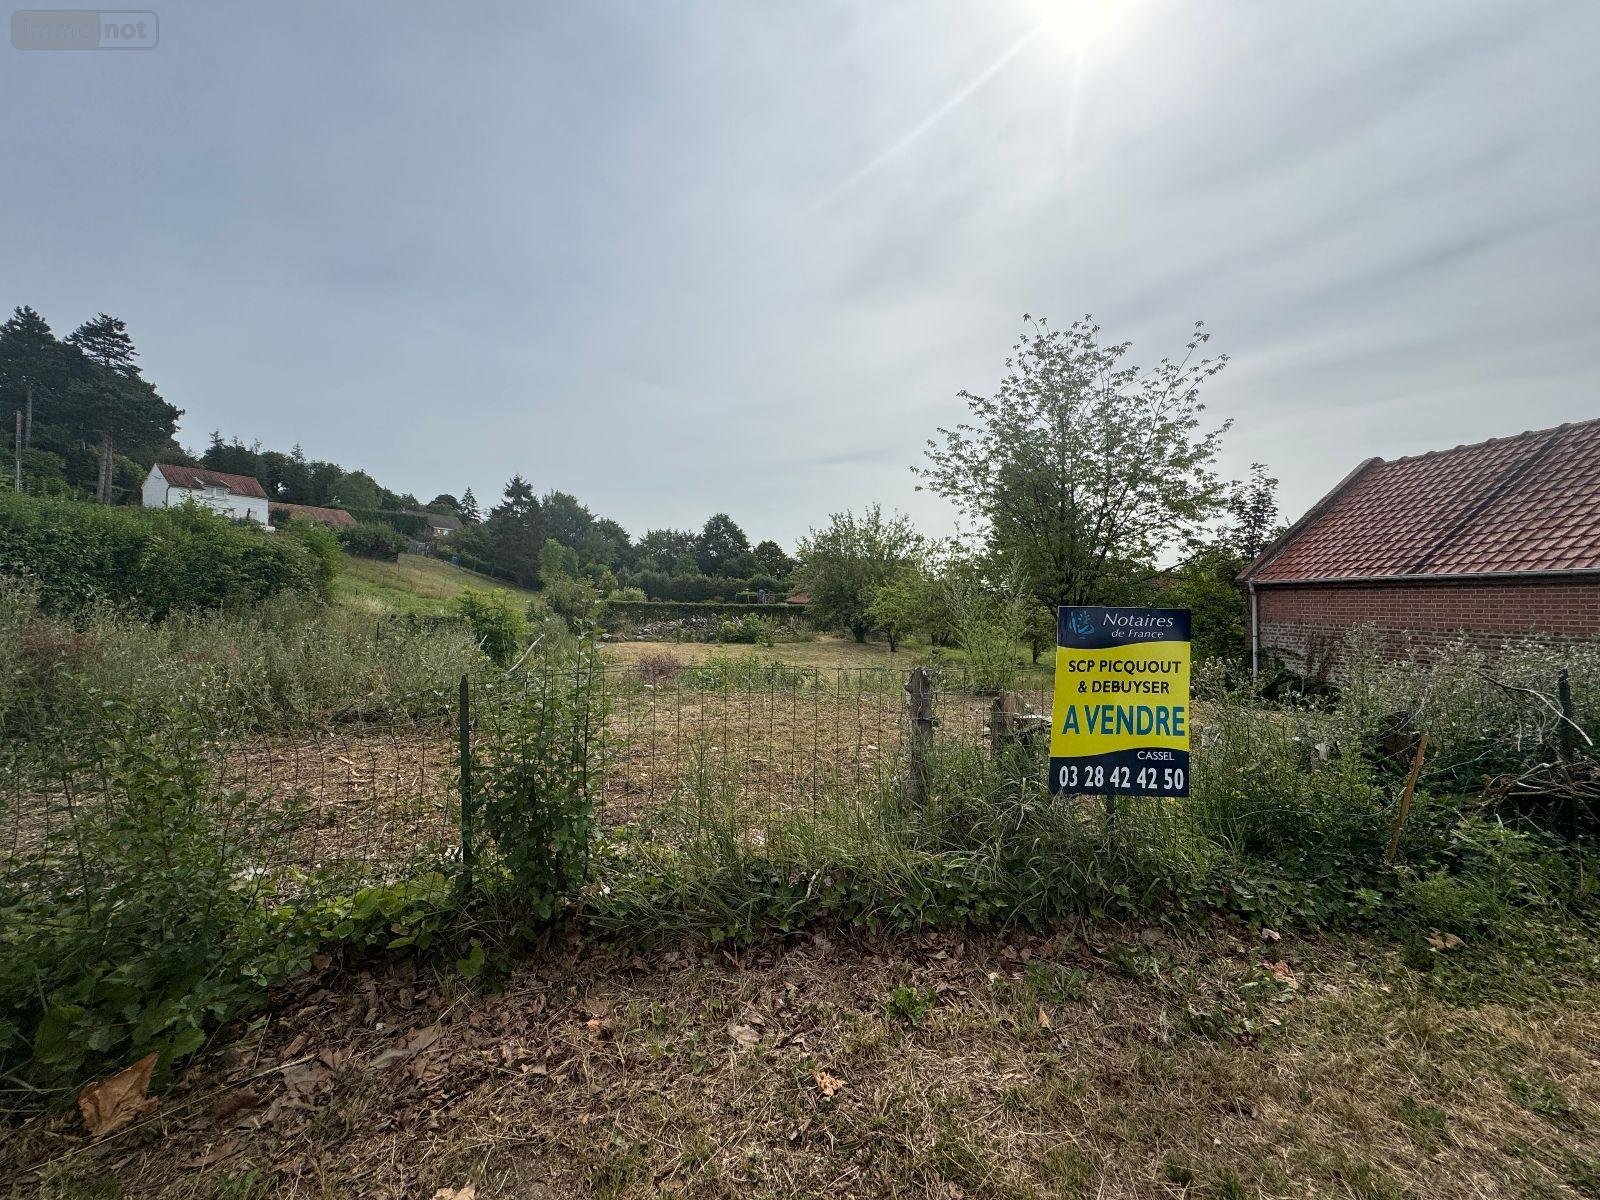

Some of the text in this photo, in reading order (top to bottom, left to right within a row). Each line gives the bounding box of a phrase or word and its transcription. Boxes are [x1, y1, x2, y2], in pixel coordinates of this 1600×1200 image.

[1102, 613, 1174, 628] Notaires
[1111, 629, 1164, 639] de France
[1068, 660, 1182, 675] SCP PICQUOUT
[1077, 680, 1170, 694] & DEBUYSER
[1061, 704, 1186, 737] A VENDRE
[1136, 750, 1175, 761] CASSEL
[1059, 765, 1185, 790] 03 28 42 42 50
